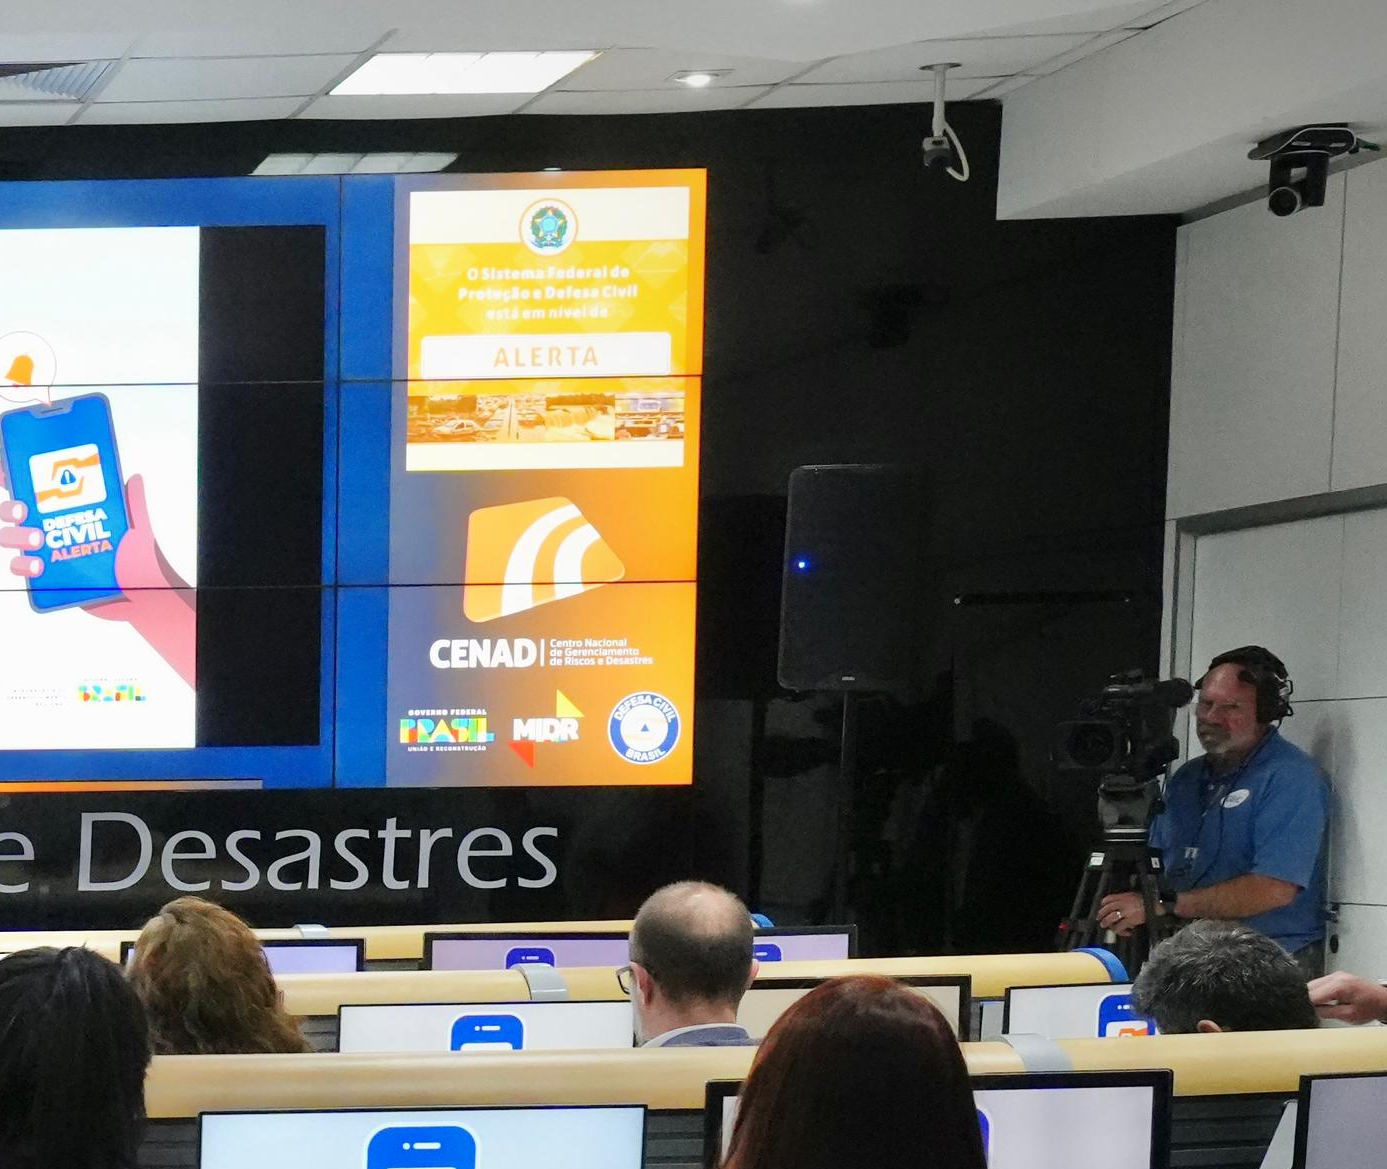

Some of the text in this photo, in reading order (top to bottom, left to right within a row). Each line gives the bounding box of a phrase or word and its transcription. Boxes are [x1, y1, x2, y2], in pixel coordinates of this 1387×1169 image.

[467, 265, 630, 280] O Sistema Federal de
[459, 285, 638, 303] Proteção e Defesa Civil
[486, 306, 609, 320] está em nível de
[493, 346, 599, 368] ALERTA
[45, 520, 112, 549] CIVIL
[50, 540, 114, 563] ALERTA
[549, 637, 628, 648] Centro Nacional
[549, 646, 640, 657] de Gerenciamento
[429, 638, 538, 669] CENAD
[549, 655, 654, 666] de Riscos e Desastres
[408, 708, 488, 717] GOVERNO FEDERAL
[613, 694, 676, 724] DEFESA CIVIL
[399, 718, 495, 744] BRASIL
[513, 718, 580, 741] MIDR
[625, 748, 668, 761] BRASIL
[77, 812, 558, 892] Desastres
